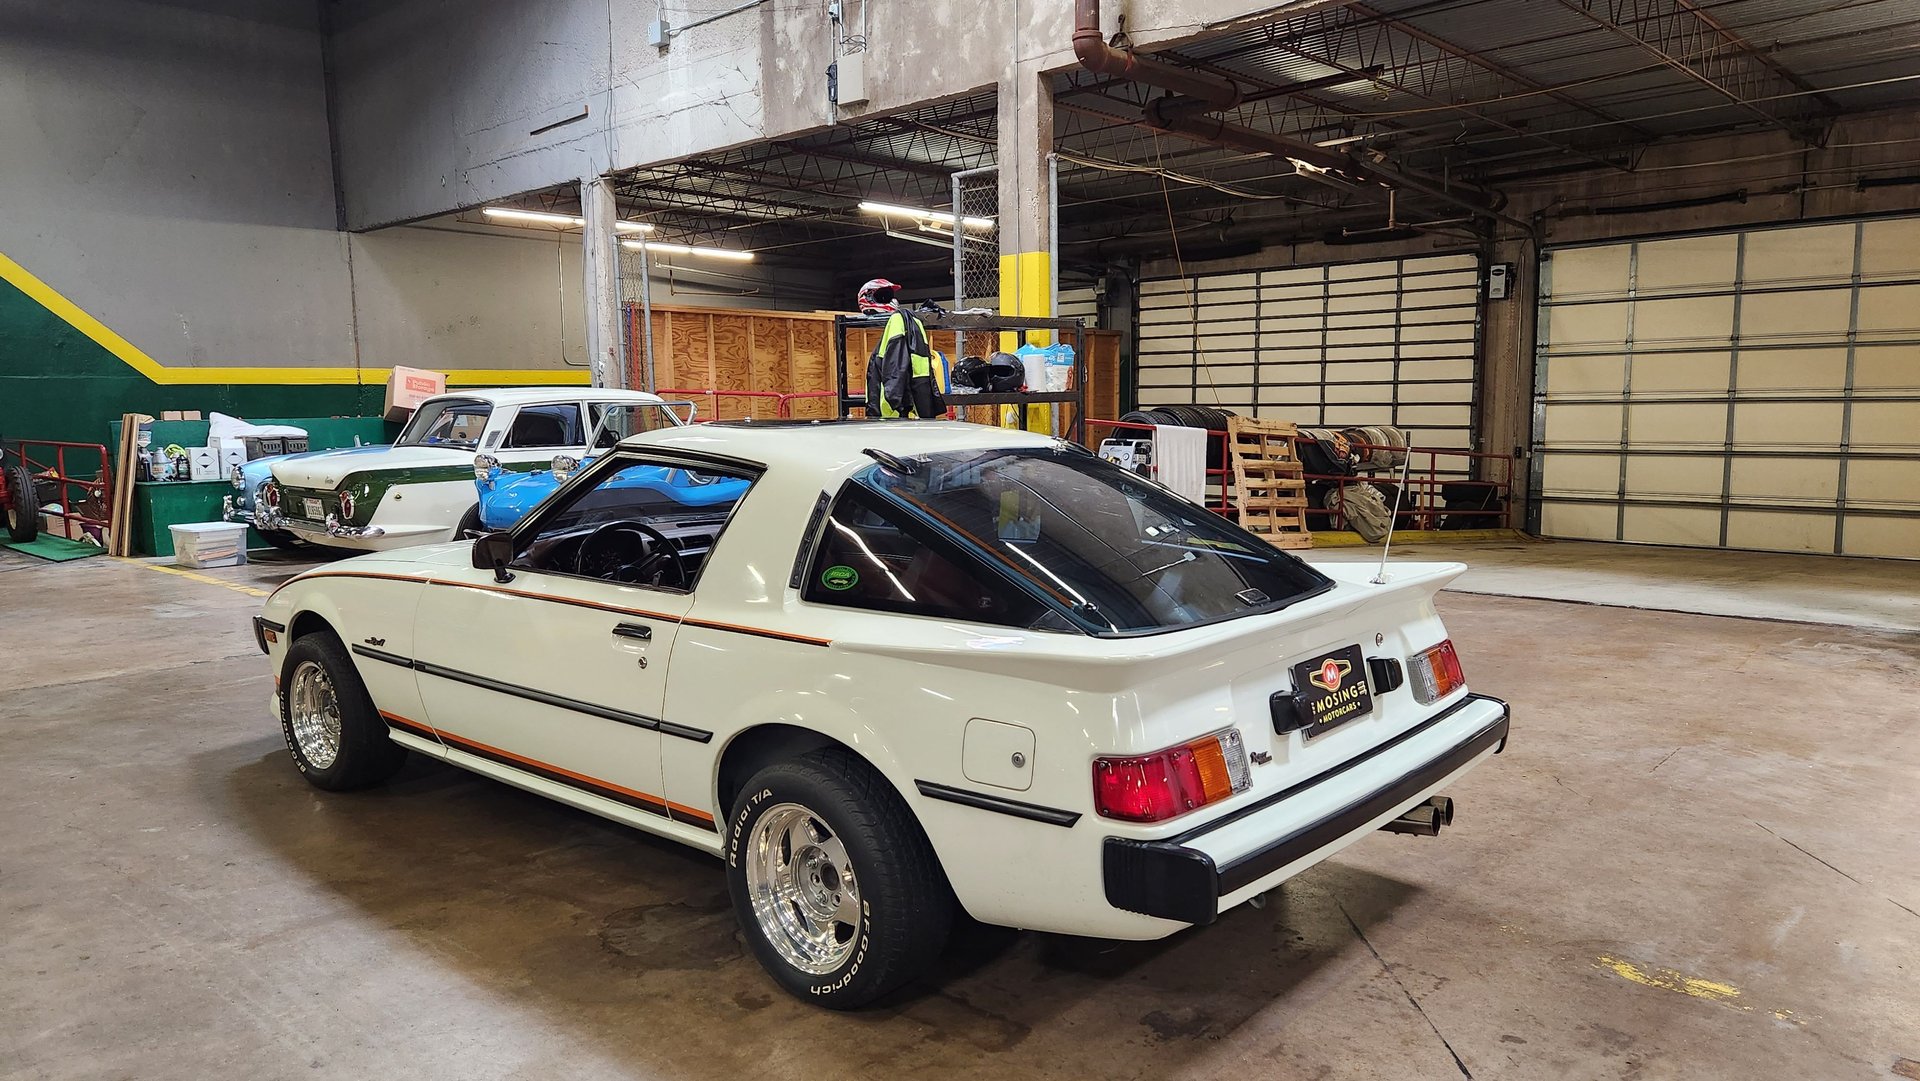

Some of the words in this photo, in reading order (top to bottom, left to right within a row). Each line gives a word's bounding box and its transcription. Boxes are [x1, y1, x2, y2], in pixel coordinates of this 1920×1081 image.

[1327, 667, 1336, 682] M
[1316, 685, 1359, 713] MOSING
[1322, 702, 1357, 723] MOTORCARS
[730, 804, 751, 868] Radial
[751, 788, 773, 805] T/A
[810, 899, 870, 996] BFGoodrich
